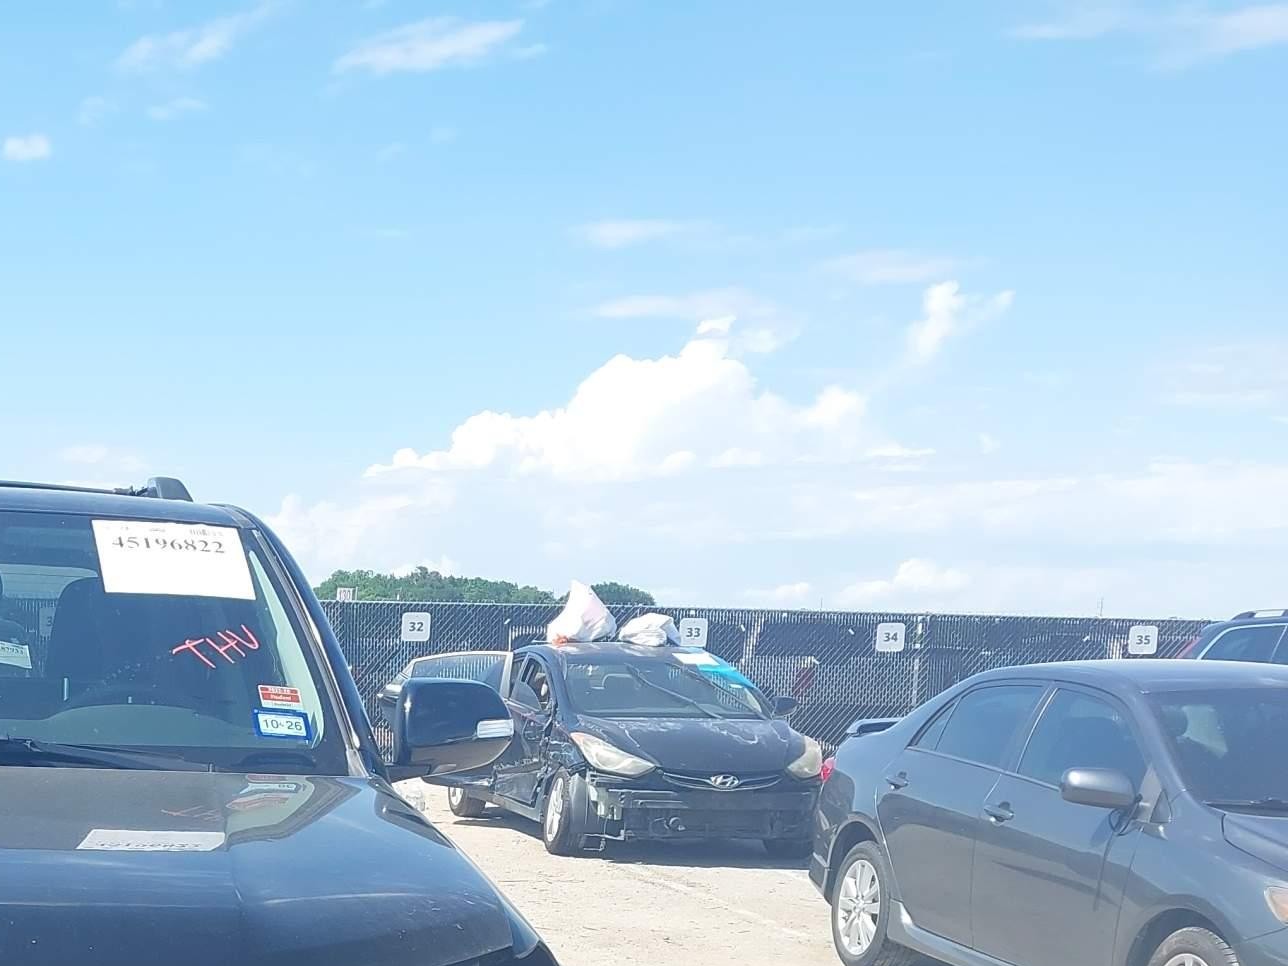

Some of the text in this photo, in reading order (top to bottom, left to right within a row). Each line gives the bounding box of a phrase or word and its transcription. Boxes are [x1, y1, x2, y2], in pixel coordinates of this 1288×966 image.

[112, 536, 225, 554] 45196822
[408, 621, 424, 632] 32
[685, 627, 701, 638] 33
[883, 632, 899, 642] 34
[1135, 635, 1152, 645] 35
[263, 719, 302, 731] 10 26
